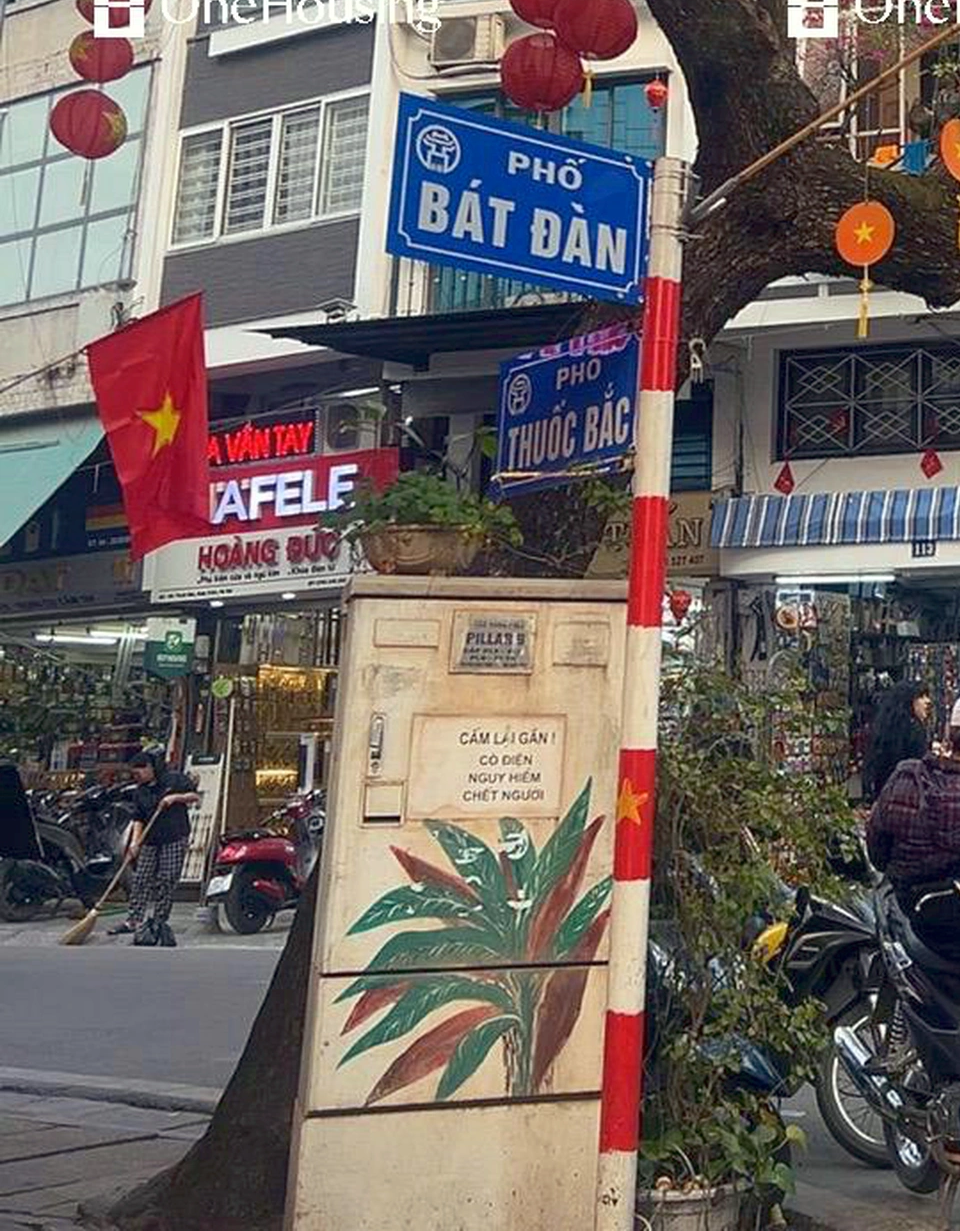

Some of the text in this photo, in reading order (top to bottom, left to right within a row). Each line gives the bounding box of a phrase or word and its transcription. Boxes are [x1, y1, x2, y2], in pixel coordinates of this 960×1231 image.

[507, 151, 583, 191] PHỐ
[417, 179, 628, 275] BÁT ĐÀN
[273, 421, 314, 456] TAY
[507, 382, 630, 470] THUỐC BẮC
[198, 536, 280, 569] HOÀNG
[468, 772, 506, 784] NGUY
